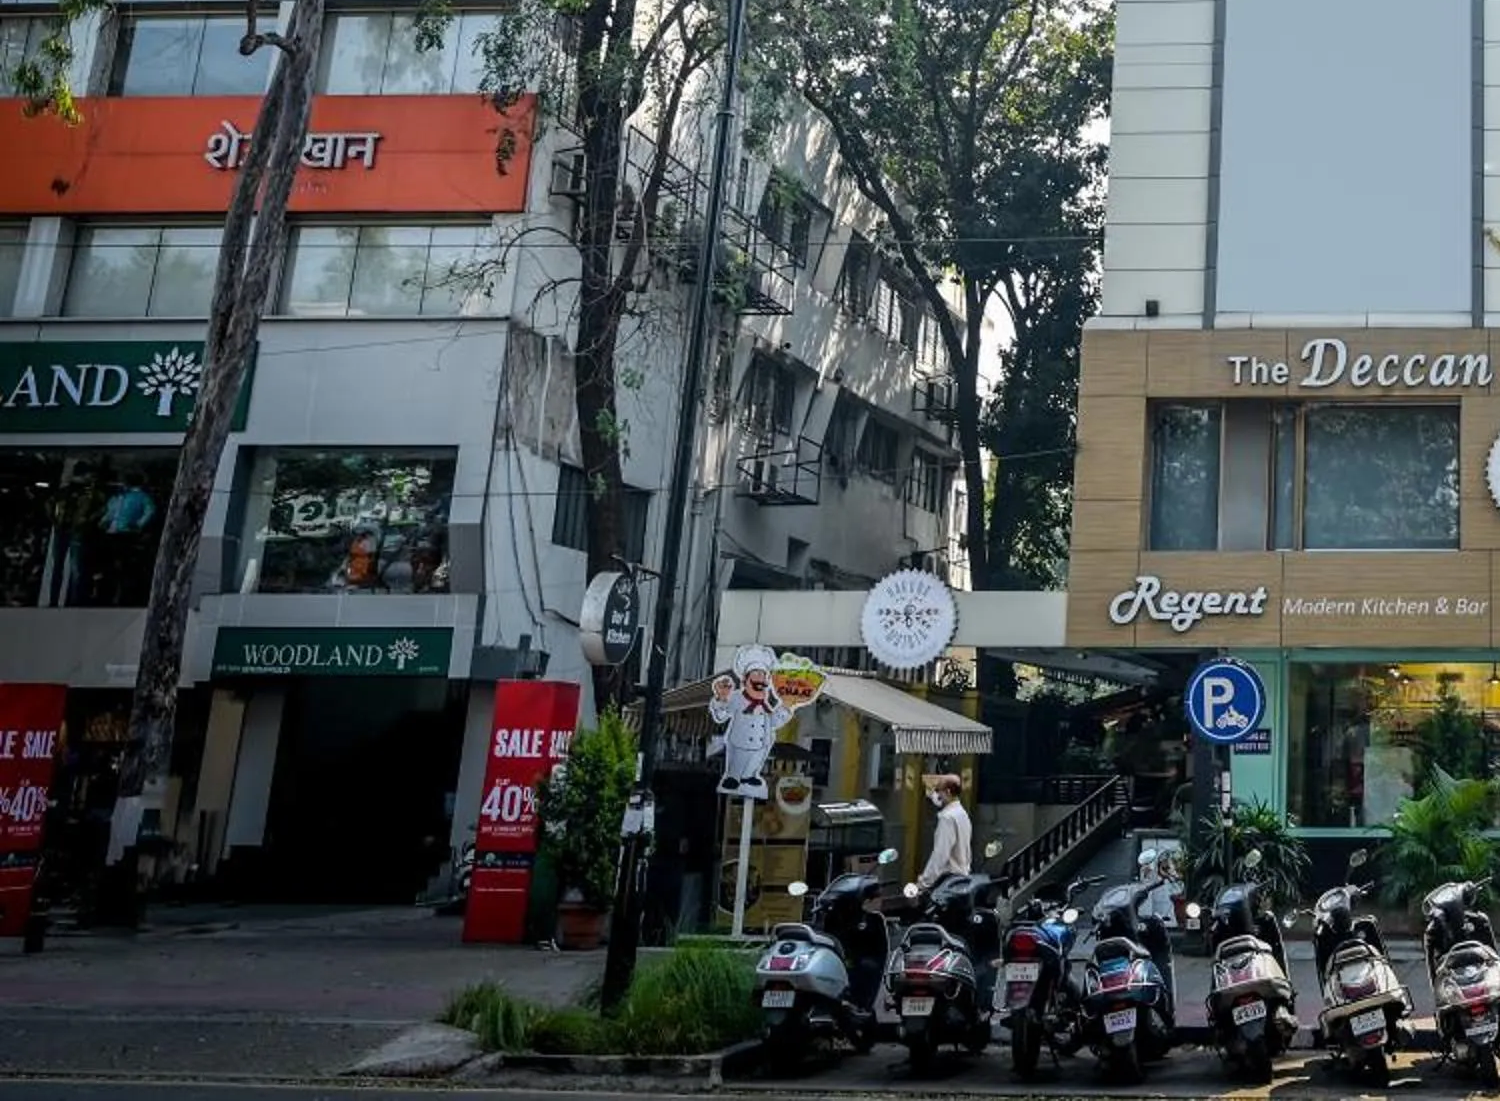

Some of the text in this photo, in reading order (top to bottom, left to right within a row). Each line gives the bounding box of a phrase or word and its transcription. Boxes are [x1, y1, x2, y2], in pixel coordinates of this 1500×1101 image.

[205, 120, 380, 169] शेखान
[0, 364, 129, 407] AND
[1229, 356, 1289, 384] The
[1301, 338, 1493, 387] Deccan
[1109, 576, 1488, 632] Regent Modern Kitchen & Bar
[243, 643, 383, 667] WOODLAND
[1203, 677, 1235, 728] P
[22, 731, 56, 759] SALE
[494, 728, 545, 758] SALE
